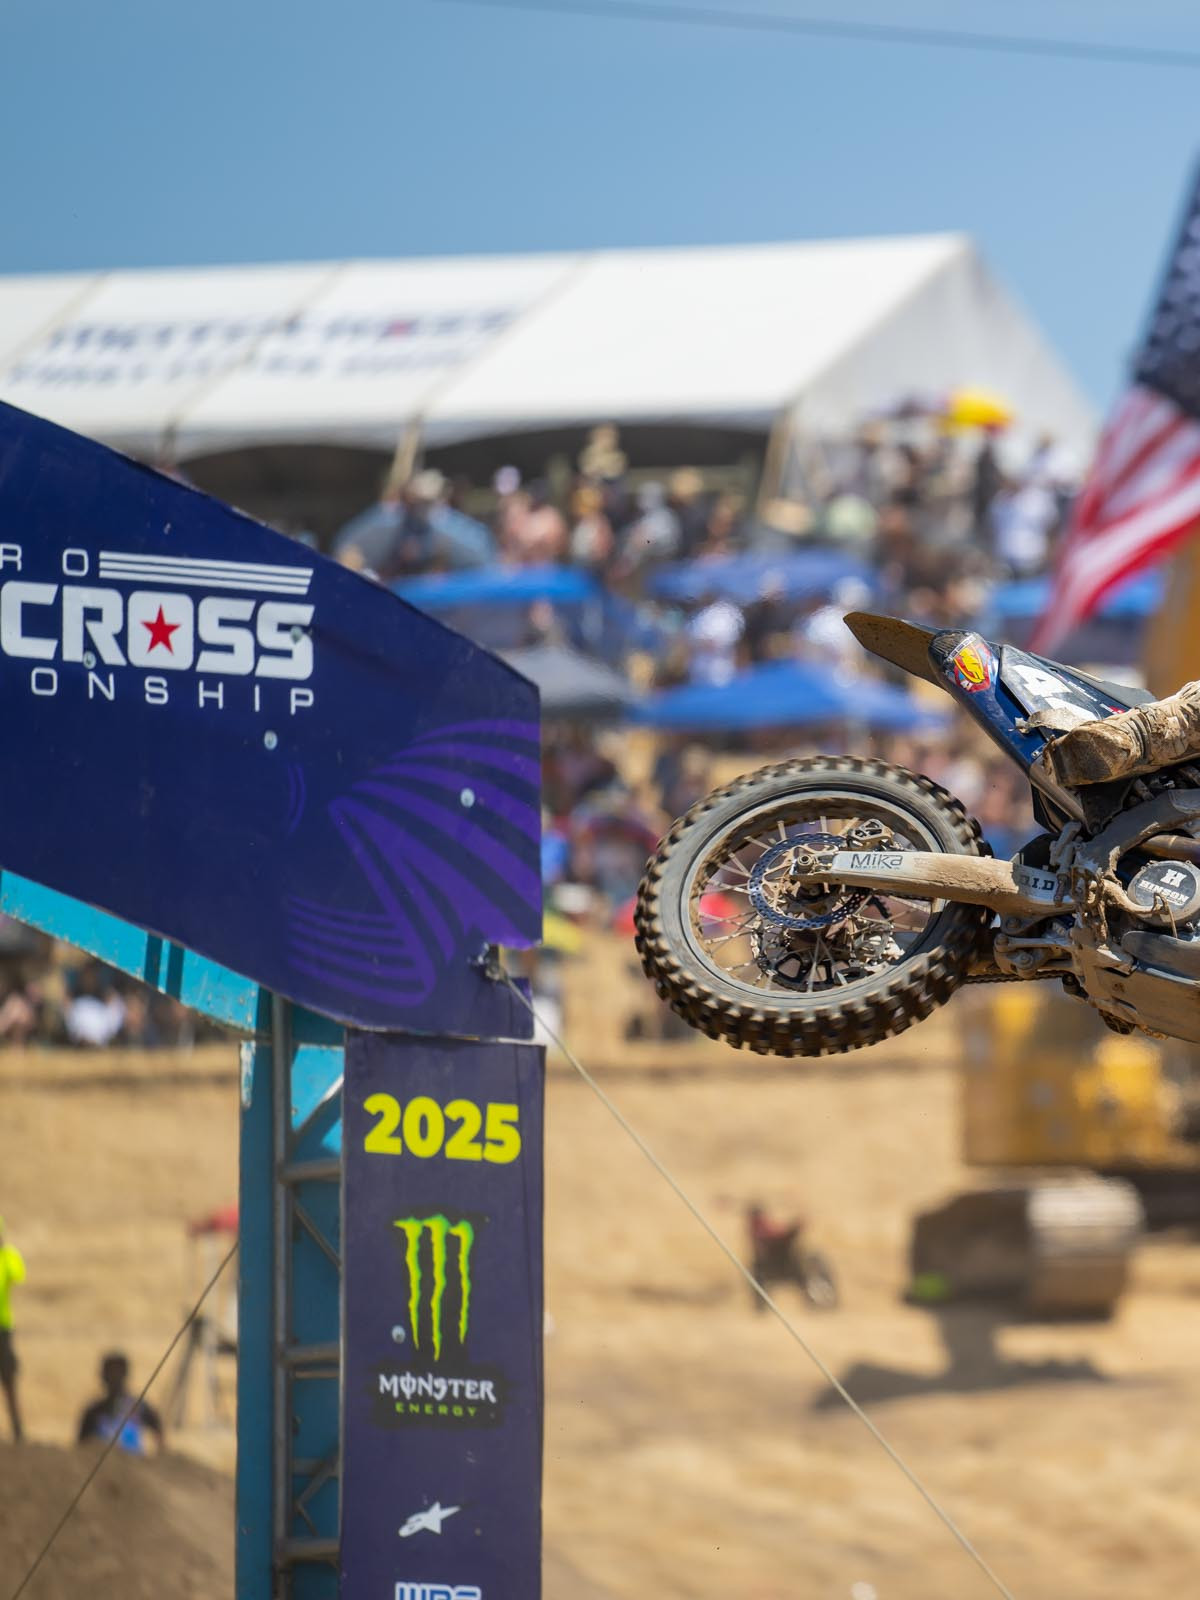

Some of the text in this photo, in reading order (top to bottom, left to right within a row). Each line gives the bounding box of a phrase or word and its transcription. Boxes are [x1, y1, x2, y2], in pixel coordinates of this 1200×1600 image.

[0, 580, 315, 681] CROSS
[30, 666, 315, 716] ONSHIP
[850, 853, 903, 869] Mika
[1137, 880, 1190, 903] HINSON
[363, 1092, 522, 1165] 2025
[379, 1371, 497, 1404] MONSTER
[395, 1402, 477, 1417] ENERGY
